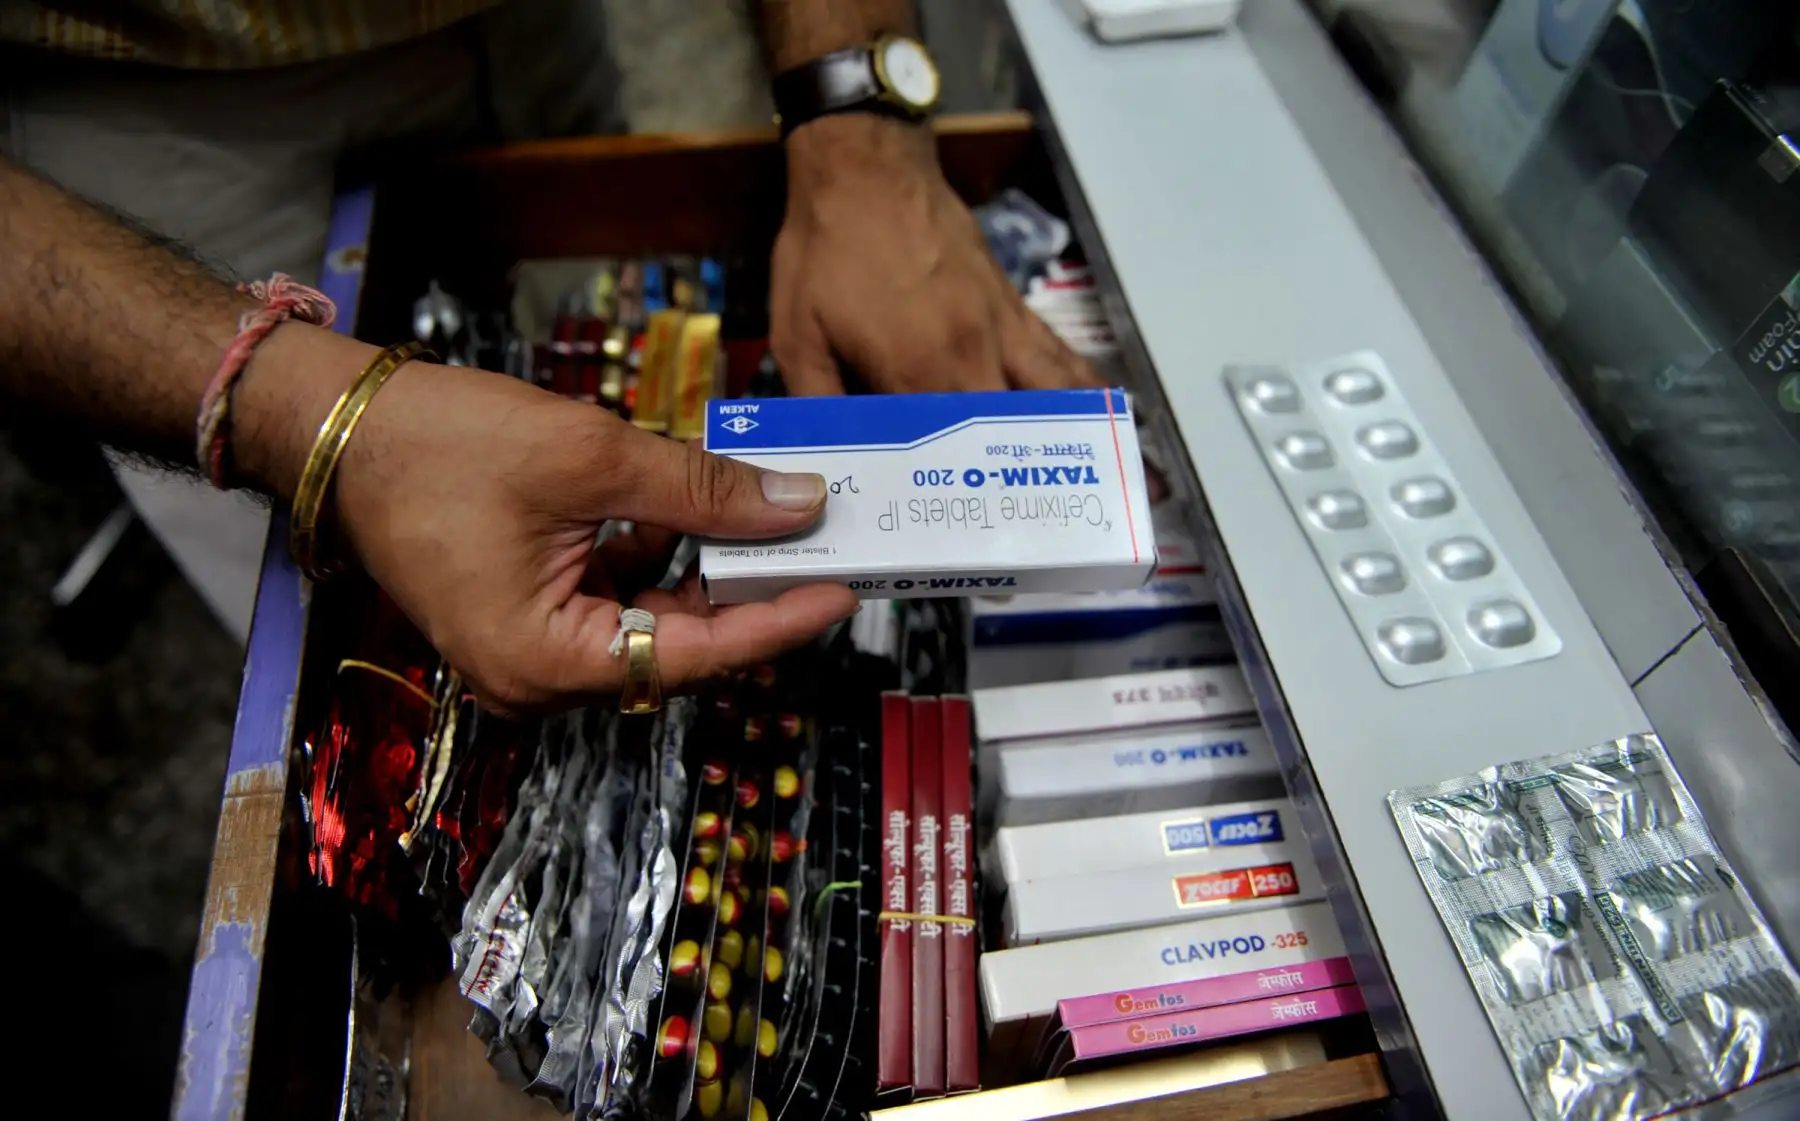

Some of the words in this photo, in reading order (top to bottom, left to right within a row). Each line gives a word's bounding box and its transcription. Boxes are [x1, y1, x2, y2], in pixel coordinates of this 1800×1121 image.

[1748, 310, 1796, 363] Foam
[720, 404, 760, 414] ALKEM
[986, 445, 1009, 456] 200
[913, 470, 953, 486] 200
[877, 501, 900, 531] IP
[907, 498, 995, 529] Tablets
[1000, 494, 1103, 527] Cefixime
[718, 549, 749, 558] Tablets
[753, 549, 763, 557] 10
[766, 548, 775, 557] of
[778, 547, 798, 556] Strip
[801, 546, 829, 555] Blister
[849, 579, 888, 591] 200
[1168, 825, 1205, 847] 500
[1256, 873, 1293, 891] 250
[1598, 894, 1623, 927] 625
[1161, 935, 1265, 966] CLAVPOD
[1621, 930, 1678, 1021] AUGMENTIN
[1115, 992, 1184, 1013] Gemfos
[1126, 1023, 1197, 1045] Gemfos
